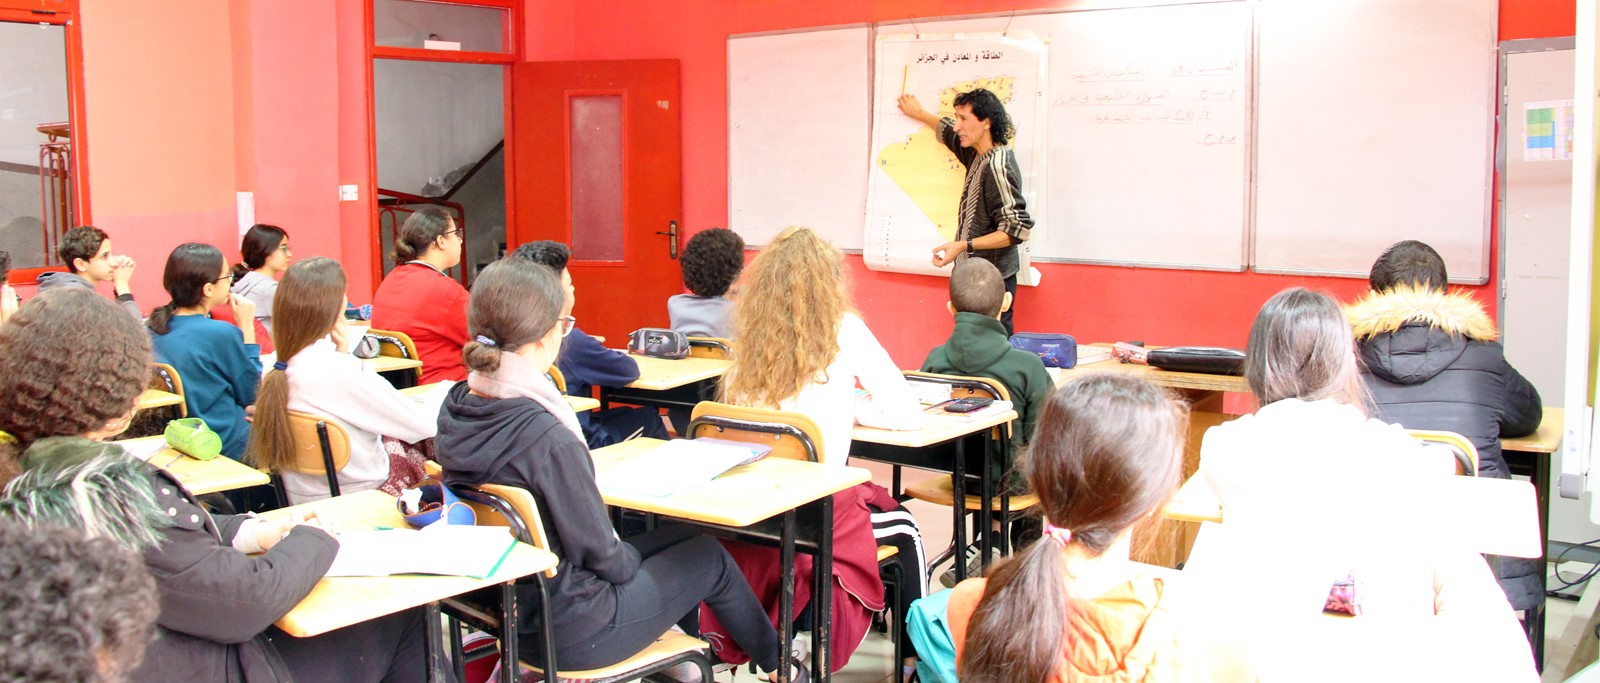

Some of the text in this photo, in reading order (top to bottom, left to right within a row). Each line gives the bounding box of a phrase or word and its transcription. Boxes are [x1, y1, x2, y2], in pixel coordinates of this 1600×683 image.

[916, 52, 938, 64] الجزائر
[940, 52, 950, 65] في
[952, 52, 971, 63] المعادن
[982, 50, 1003, 60] الطاقة
